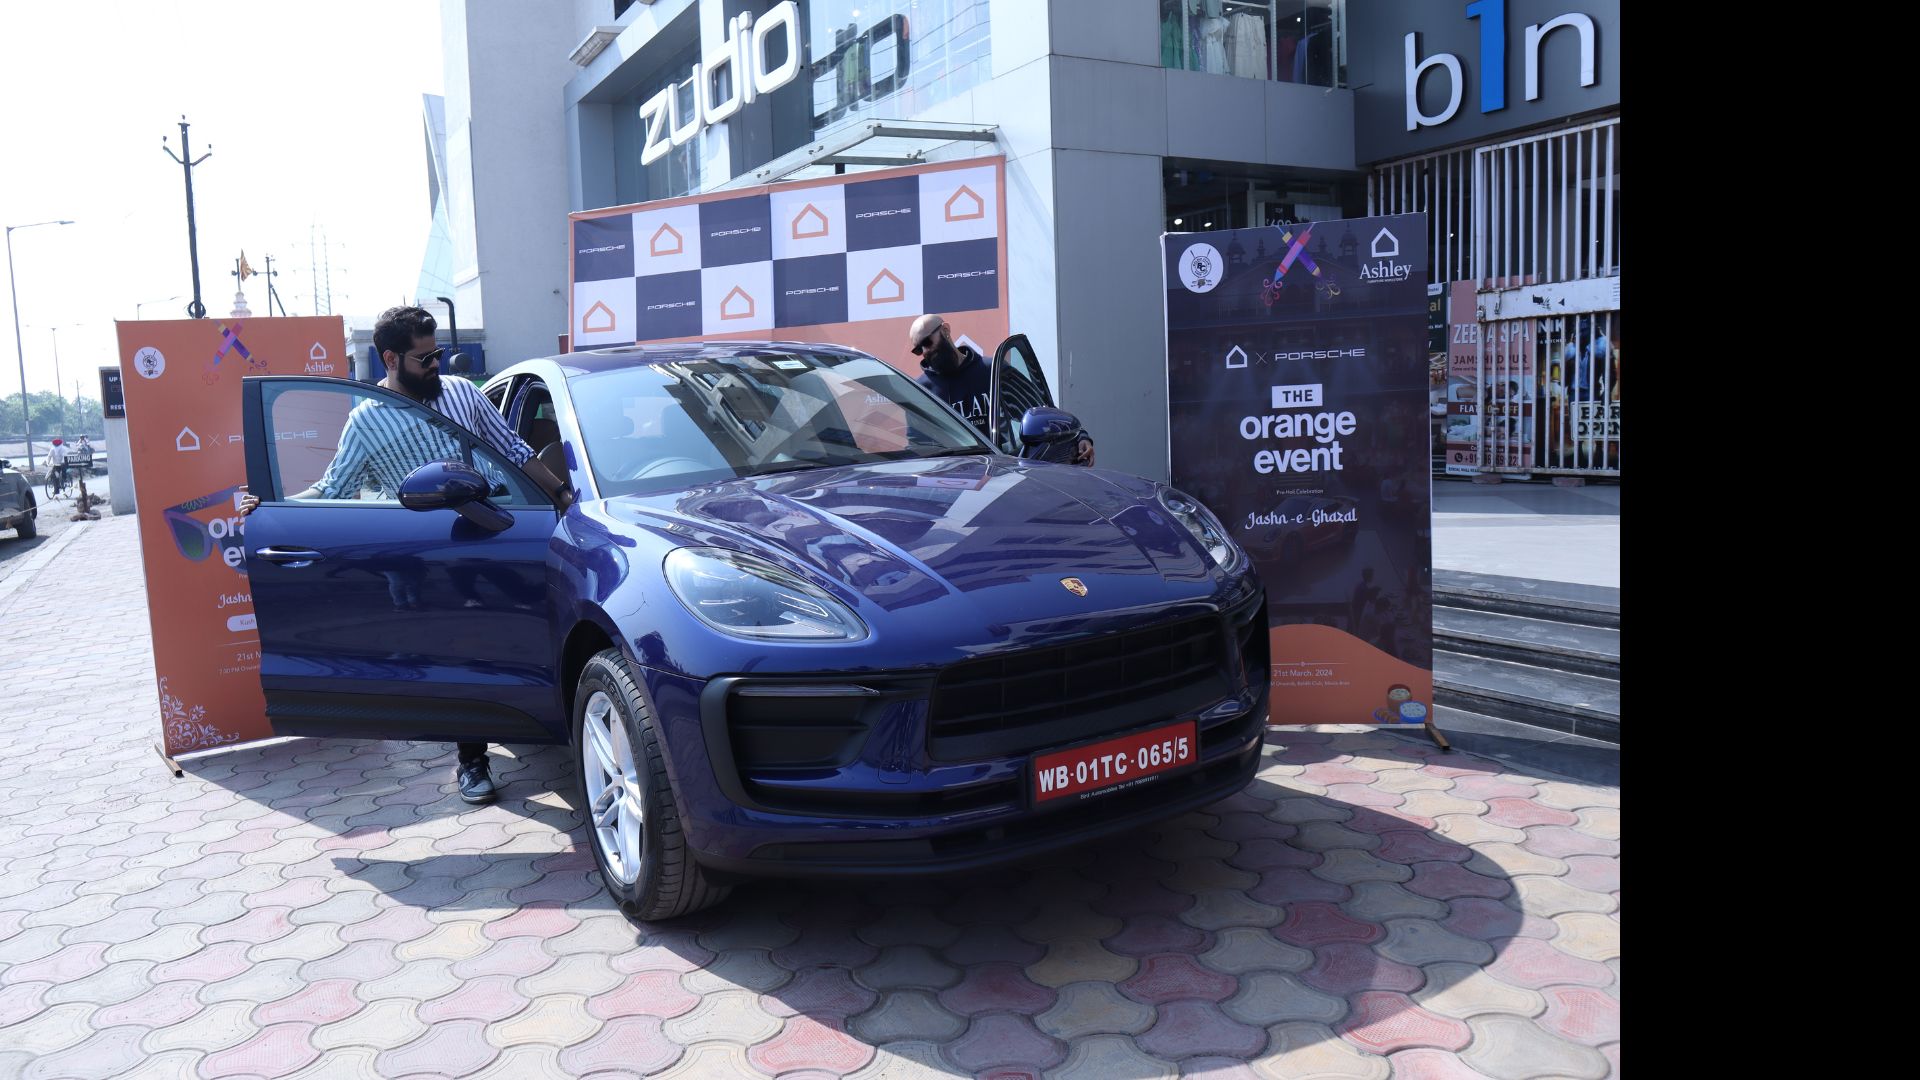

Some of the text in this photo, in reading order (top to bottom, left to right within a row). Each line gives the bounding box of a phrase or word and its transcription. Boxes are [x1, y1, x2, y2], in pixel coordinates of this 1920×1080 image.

[640, 1, 799, 165] zudio
[855, 208, 912, 218] PORSCHE
[711, 226, 761, 238] PORSCHE
[578, 244, 626, 254] PORSCHE
[937, 269, 995, 279] PORSCHE
[1359, 260, 1412, 280] Ashley
[785, 286, 840, 295] PORSCHE
[647, 301, 696, 310] PORSCHE
[1274, 348, 1366, 361] PORSCHE
[304, 361, 335, 374] Ashley
[1282, 390, 1314, 403] THE
[1239, 411, 1357, 443] orange
[1254, 441, 1343, 474] event
[1245, 511, 1288, 529] Jashn
[237, 652, 254, 662] 21st
[1315, 668, 1333, 677] 2024
